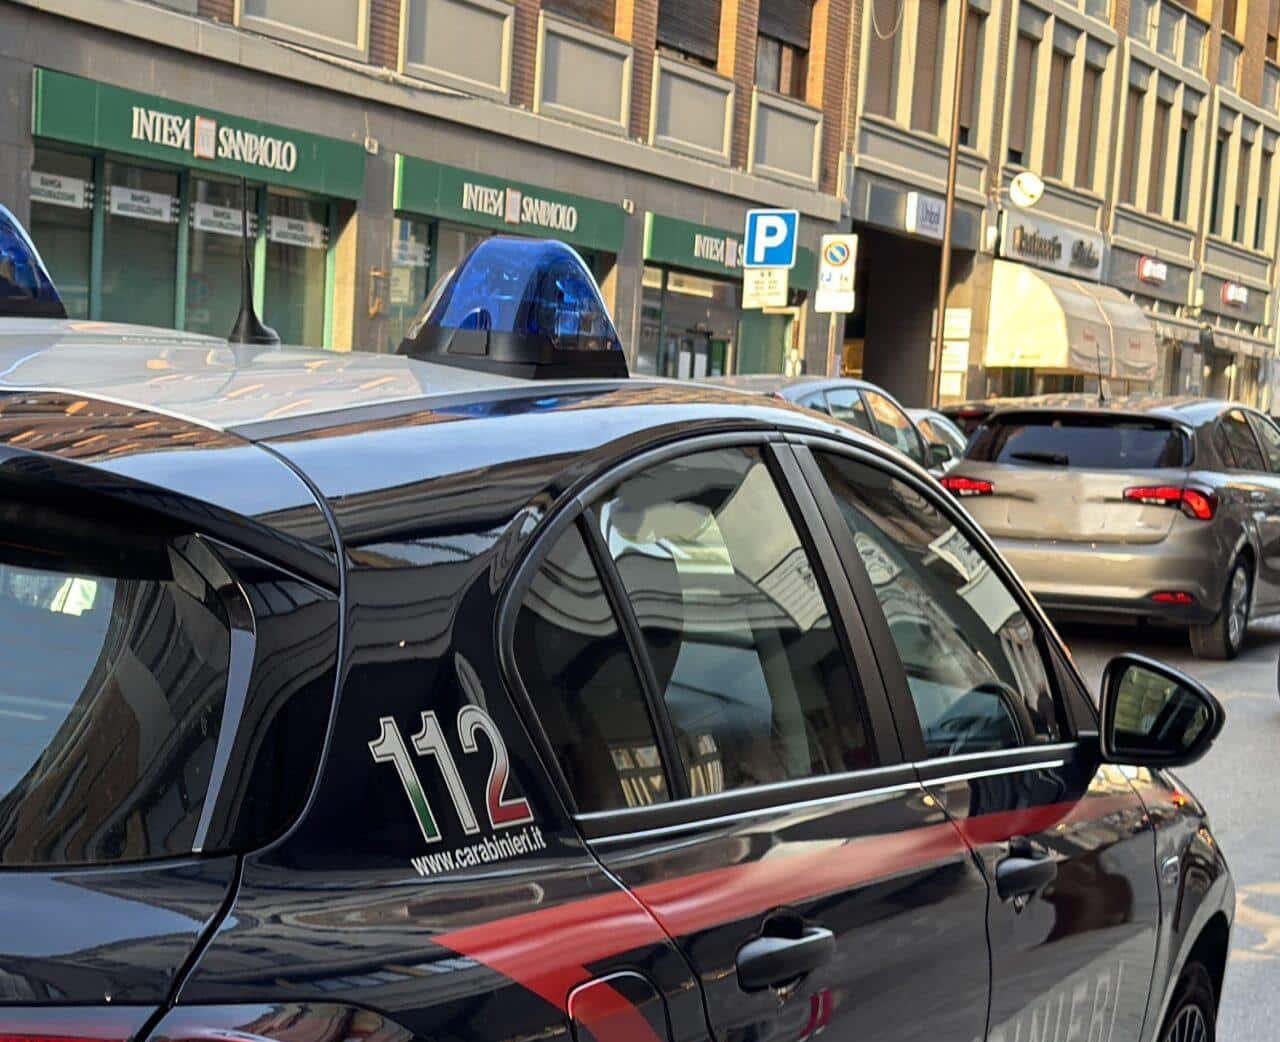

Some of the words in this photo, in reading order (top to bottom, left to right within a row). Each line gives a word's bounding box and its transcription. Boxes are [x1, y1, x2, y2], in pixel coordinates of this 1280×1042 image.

[131, 105, 192, 151] INTESA
[218, 125, 298, 173] SANPAOLO
[462, 182, 504, 217] INTESA
[521, 196, 577, 232] SANPAOLO
[753, 214, 788, 263] P
[368, 704, 535, 843] 112
[411, 825, 547, 877] www.carabinieri.it
